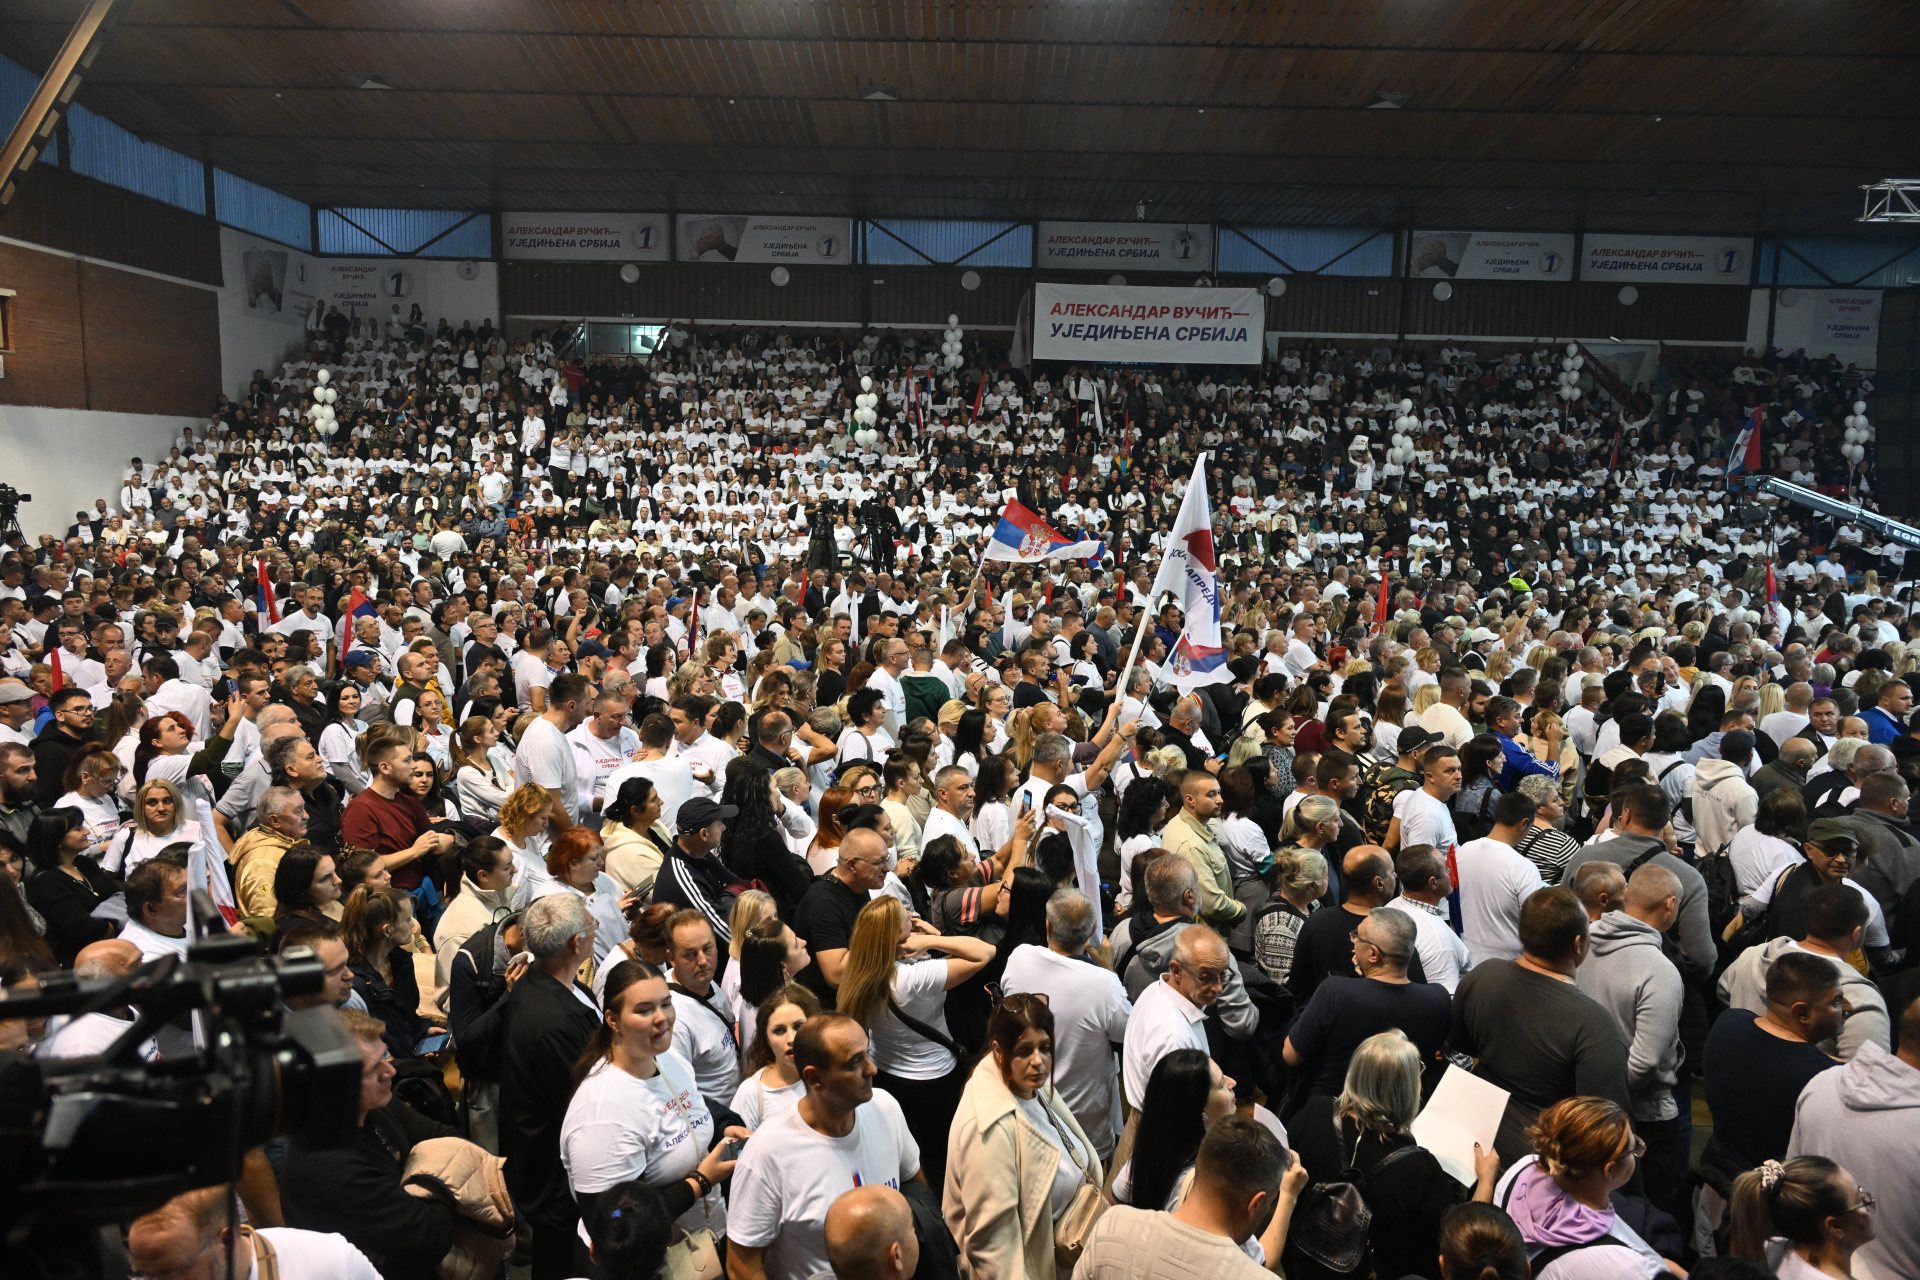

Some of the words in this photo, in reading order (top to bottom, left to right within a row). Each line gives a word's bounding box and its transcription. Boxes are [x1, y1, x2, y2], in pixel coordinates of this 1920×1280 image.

[508, 226, 576, 236] АЛЕКСАНДАР
[640, 226, 652, 250] 1
[1048, 235, 1116, 246] АЛЕКСАНДАР
[509, 238, 576, 248] УЈЕДИЊЕНА
[579, 239, 621, 249] СРБИЈА
[823, 238, 833, 257] 1
[1048, 247, 1116, 258] УЈЕДИЊЕНА
[1119, 248, 1161, 259] СРБИЈА
[1591, 248, 1660, 258] АЛЕКСАНДАР
[1545, 254, 1556, 273] 1
[1590, 260, 1658, 271] УЈЕДИЊЕНА
[1661, 262, 1703, 272] СРБИЈА
[1722, 250, 1736, 273] 1
[390, 272, 404, 298] 1
[1050, 302, 1170, 321] АЛЕКСАНДАР
[1050, 323, 1171, 342] УЈЕДИЊЕНА
[1176, 326, 1248, 342] СРБИЈА
